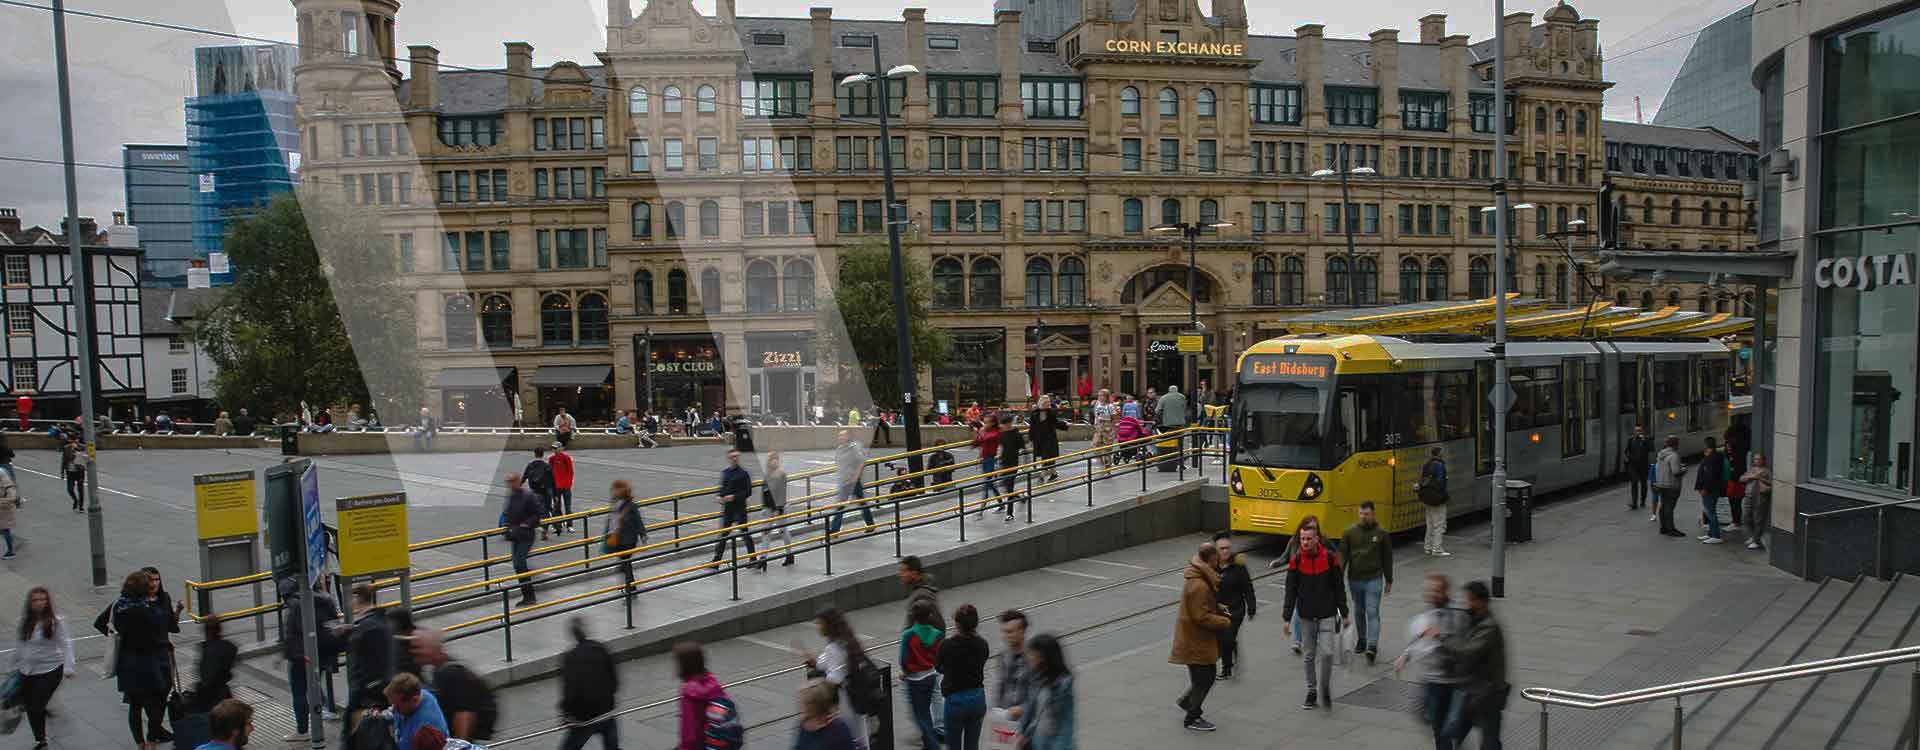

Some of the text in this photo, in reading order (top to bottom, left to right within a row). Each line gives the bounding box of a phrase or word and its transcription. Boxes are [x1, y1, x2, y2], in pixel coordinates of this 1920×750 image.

[1105, 39, 1243, 56] CORN EXCHANGE
[1815, 253, 1912, 291] COSTA
[649, 361, 714, 373] COSY CLUB
[1253, 360, 1327, 378] East Didsbury
[1257, 488, 1281, 498] 3075
